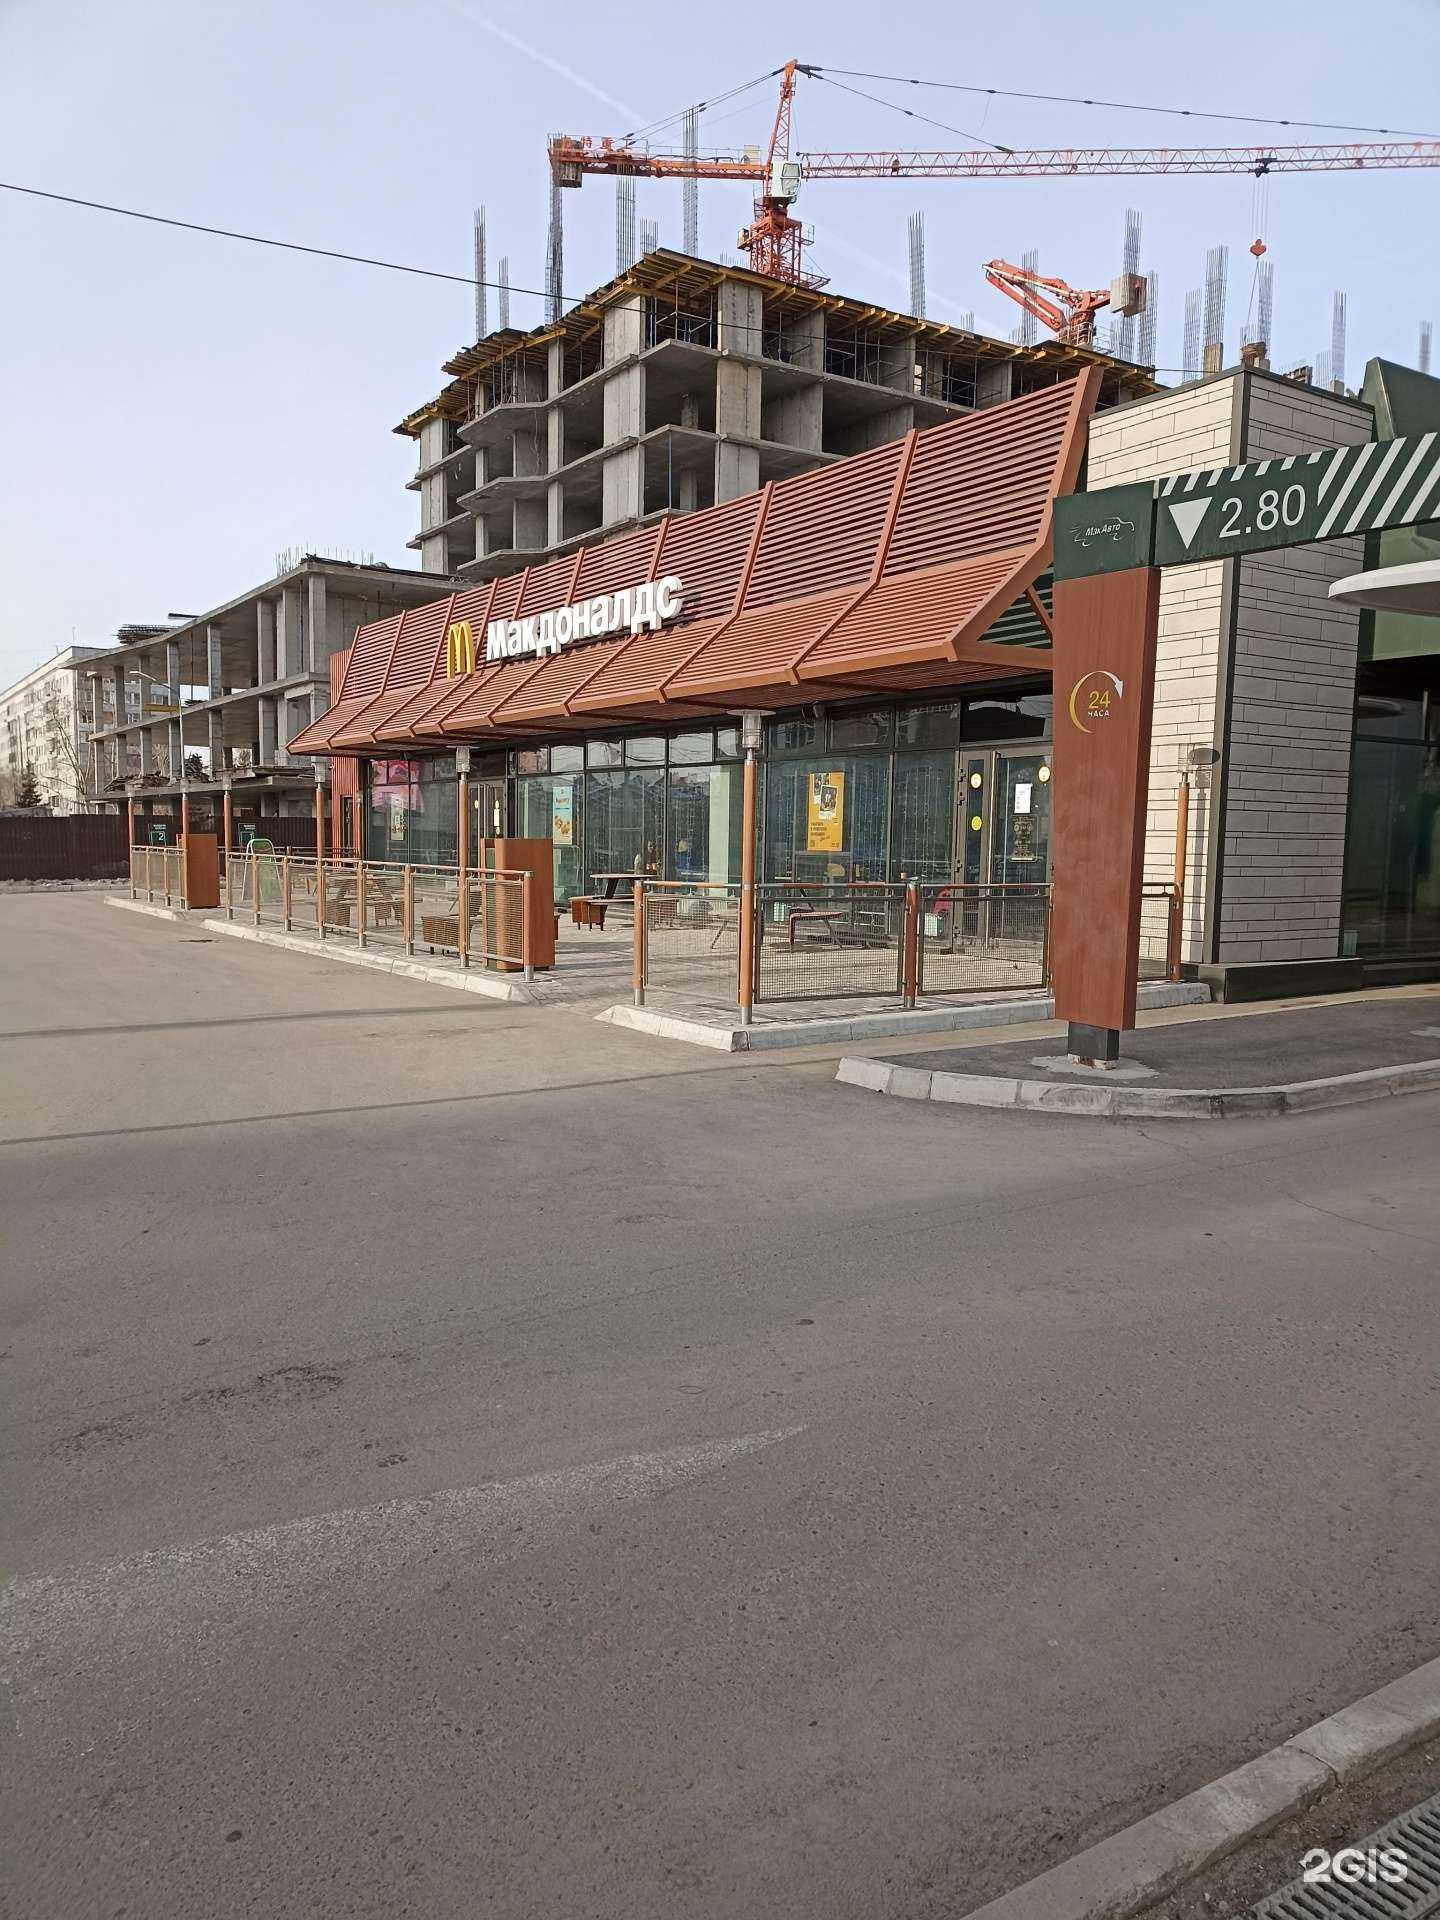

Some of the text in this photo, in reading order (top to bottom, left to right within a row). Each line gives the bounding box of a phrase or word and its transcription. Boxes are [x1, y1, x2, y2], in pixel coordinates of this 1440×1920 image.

[1219, 484, 1306, 540] 2.80
[486, 575, 684, 662] Макдоналдс
[1088, 690, 1111, 709] 24
[1087, 709, 1110, 718] ЧАСА
[158, 832, 164, 841] 2
